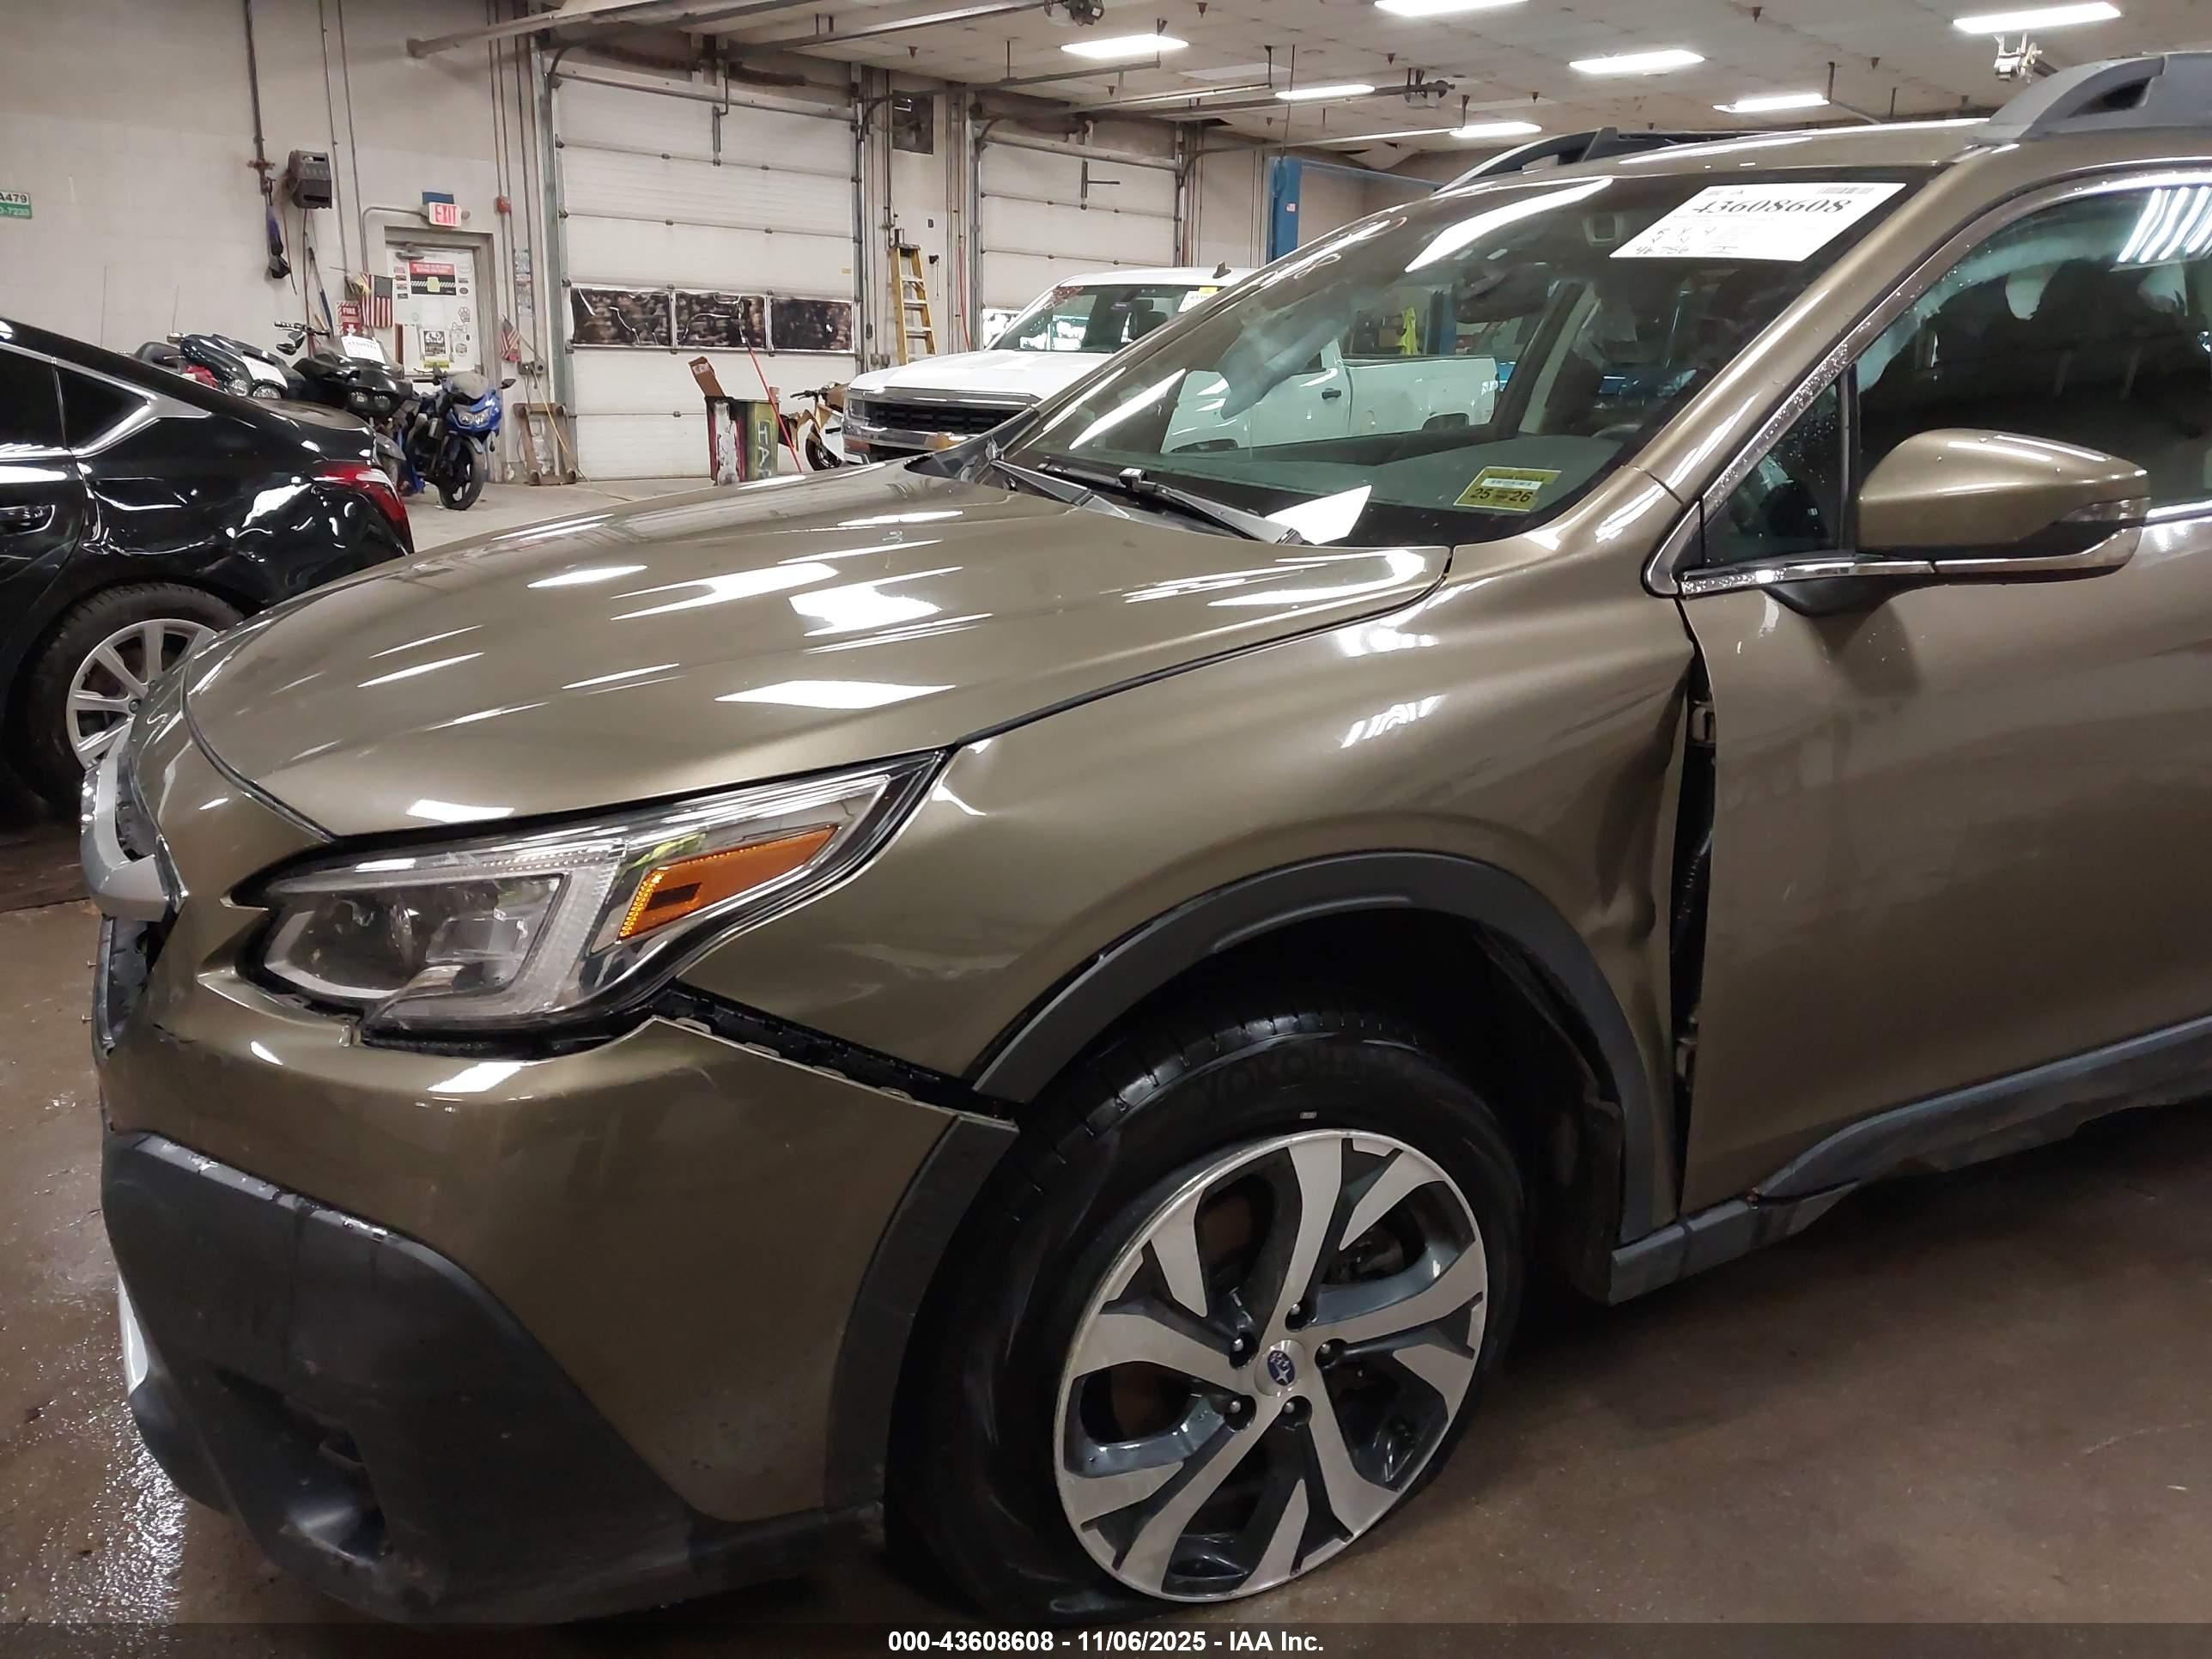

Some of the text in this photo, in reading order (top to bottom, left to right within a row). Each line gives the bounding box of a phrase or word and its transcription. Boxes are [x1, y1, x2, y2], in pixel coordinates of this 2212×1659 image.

[434, 204, 457, 224] EXIT
[1692, 198, 1852, 214] 43608608
[1470, 488, 1492, 500] 25
[1509, 490, 1533, 502] 26
